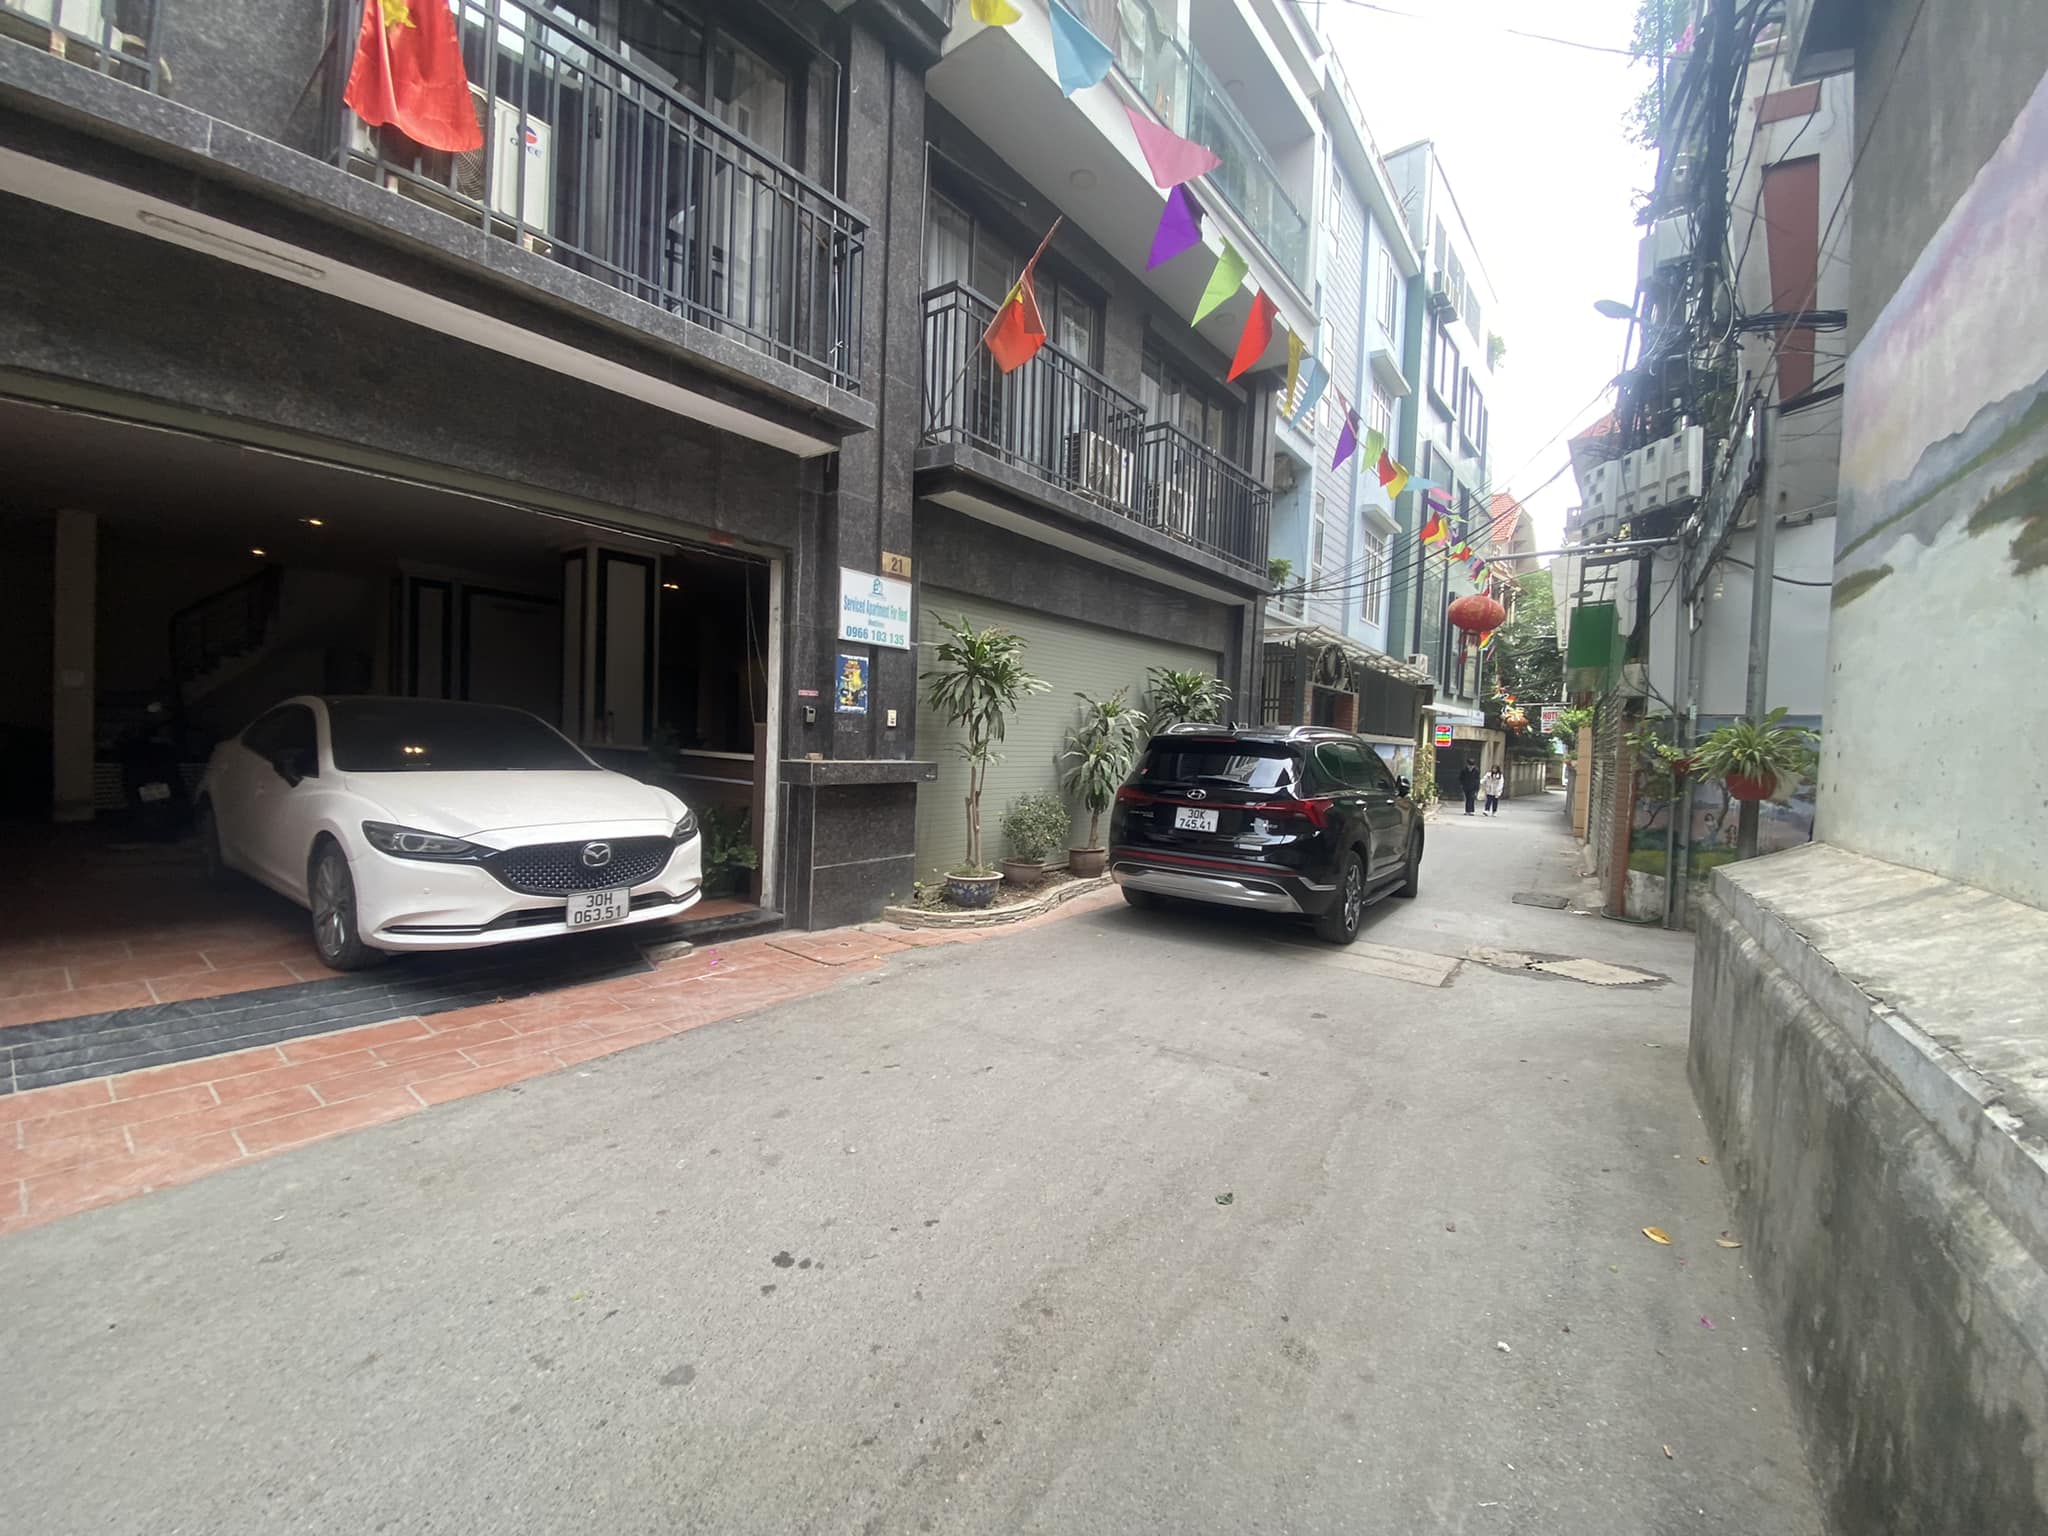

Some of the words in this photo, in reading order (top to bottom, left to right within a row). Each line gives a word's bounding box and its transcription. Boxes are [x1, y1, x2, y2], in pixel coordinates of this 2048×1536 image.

[891, 557, 903, 574] 21
[843, 596, 865, 614] Serviced
[846, 626, 868, 640] 0966
[889, 633, 904, 646] 135
[1188, 809, 1205, 820] 30K
[1179, 818, 1212, 831] 745.41
[586, 893, 612, 908] 30H
[574, 905, 621, 924] 063.51
